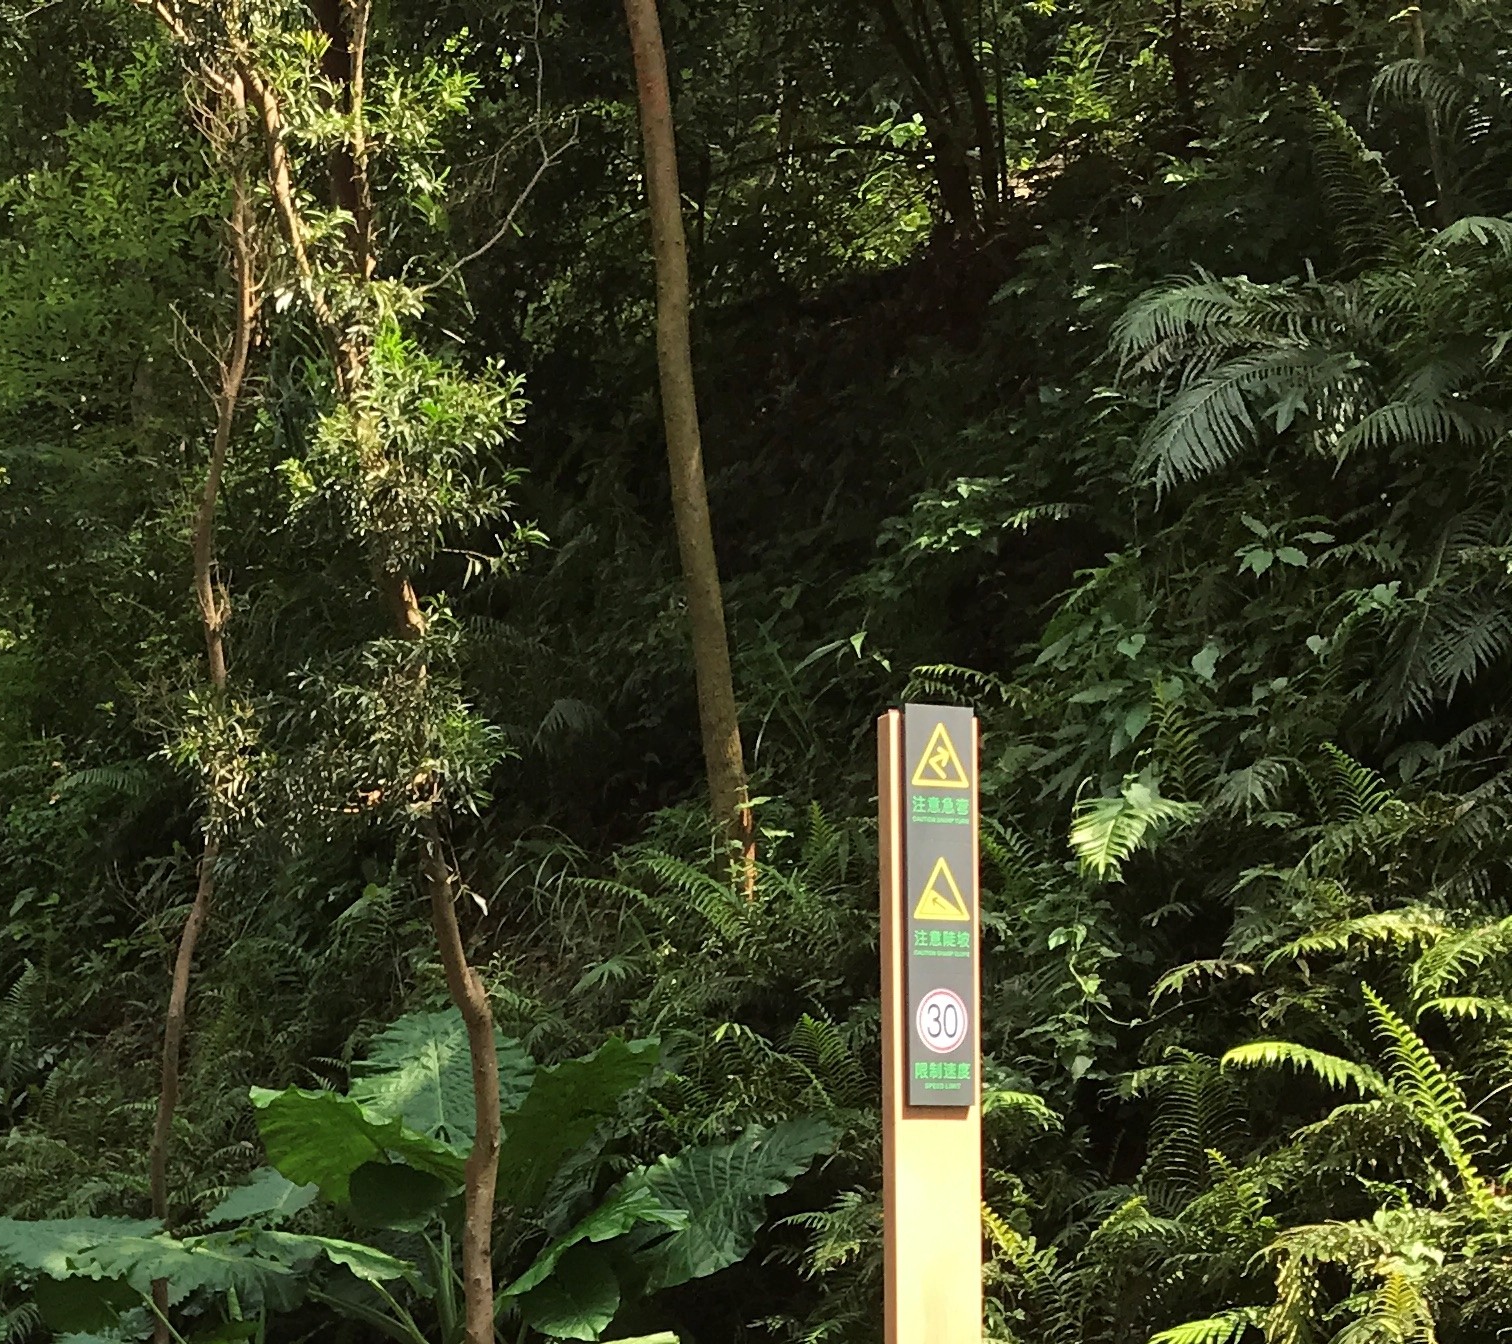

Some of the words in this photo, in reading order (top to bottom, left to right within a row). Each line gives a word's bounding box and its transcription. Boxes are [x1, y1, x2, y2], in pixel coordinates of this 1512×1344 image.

[912, 795, 970, 816] 注意急弯
[914, 929, 970, 948] 注意陡坡
[927, 1003, 958, 1039] 30
[914, 1062, 971, 1080] 限制速度
